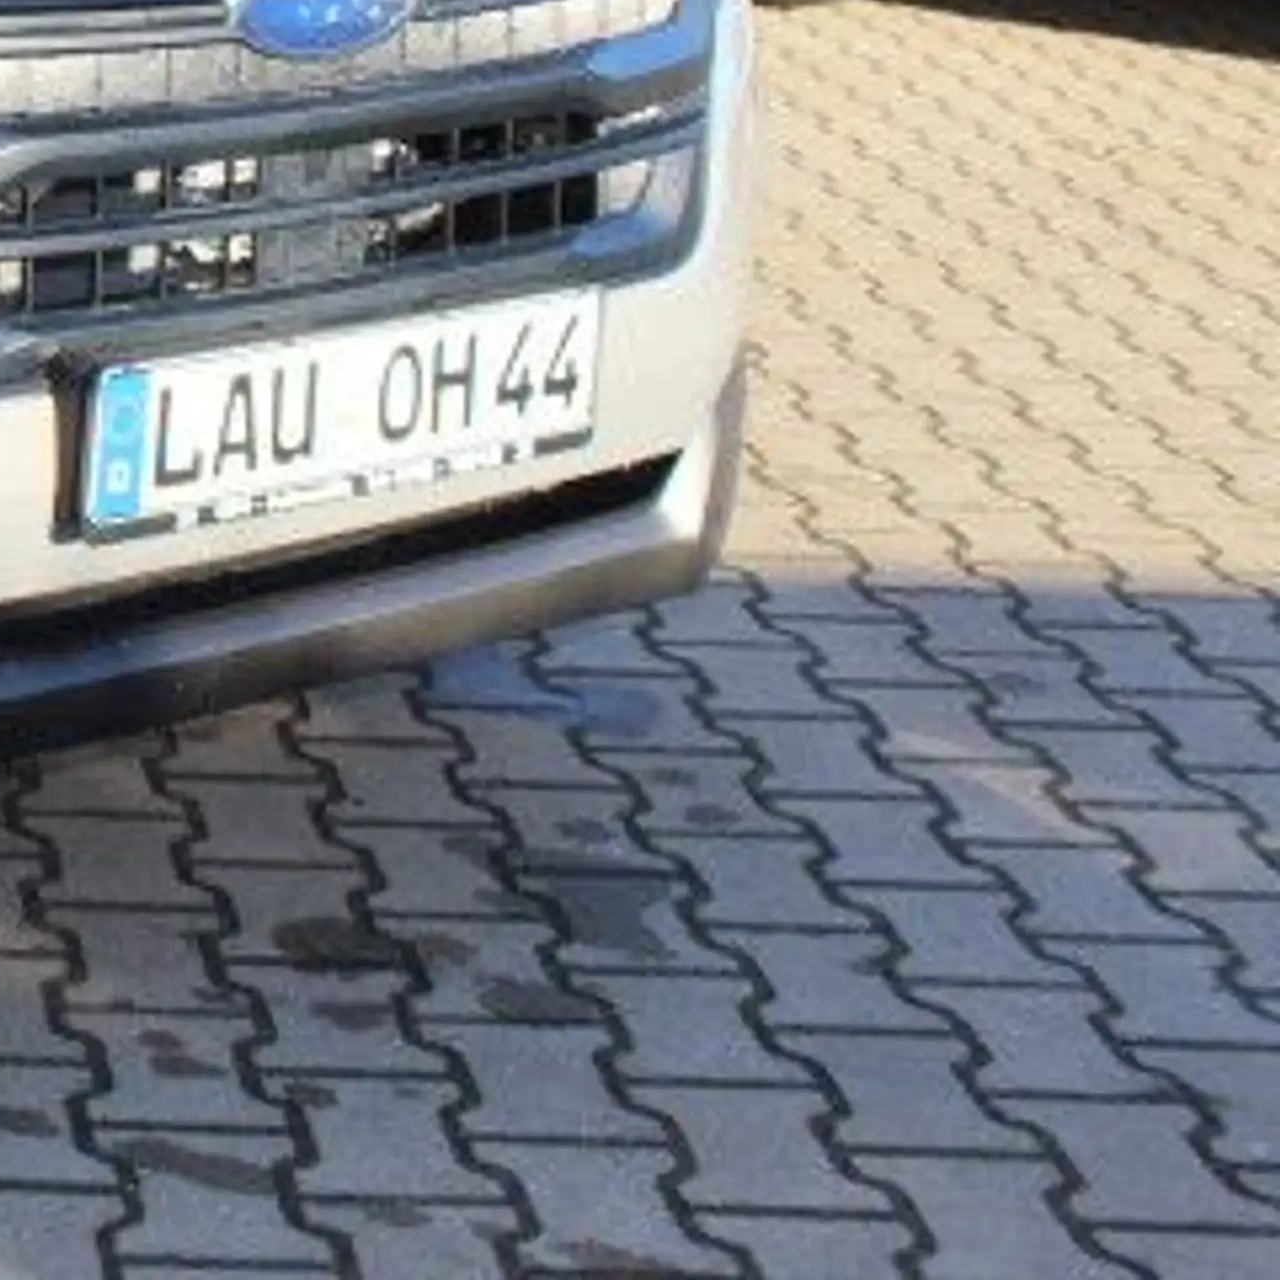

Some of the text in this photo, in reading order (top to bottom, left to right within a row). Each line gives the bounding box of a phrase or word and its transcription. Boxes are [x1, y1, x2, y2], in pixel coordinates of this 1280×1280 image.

[155, 360, 319, 487] LAU
[378, 333, 478, 441] OH
[495, 316, 579, 415] 44
